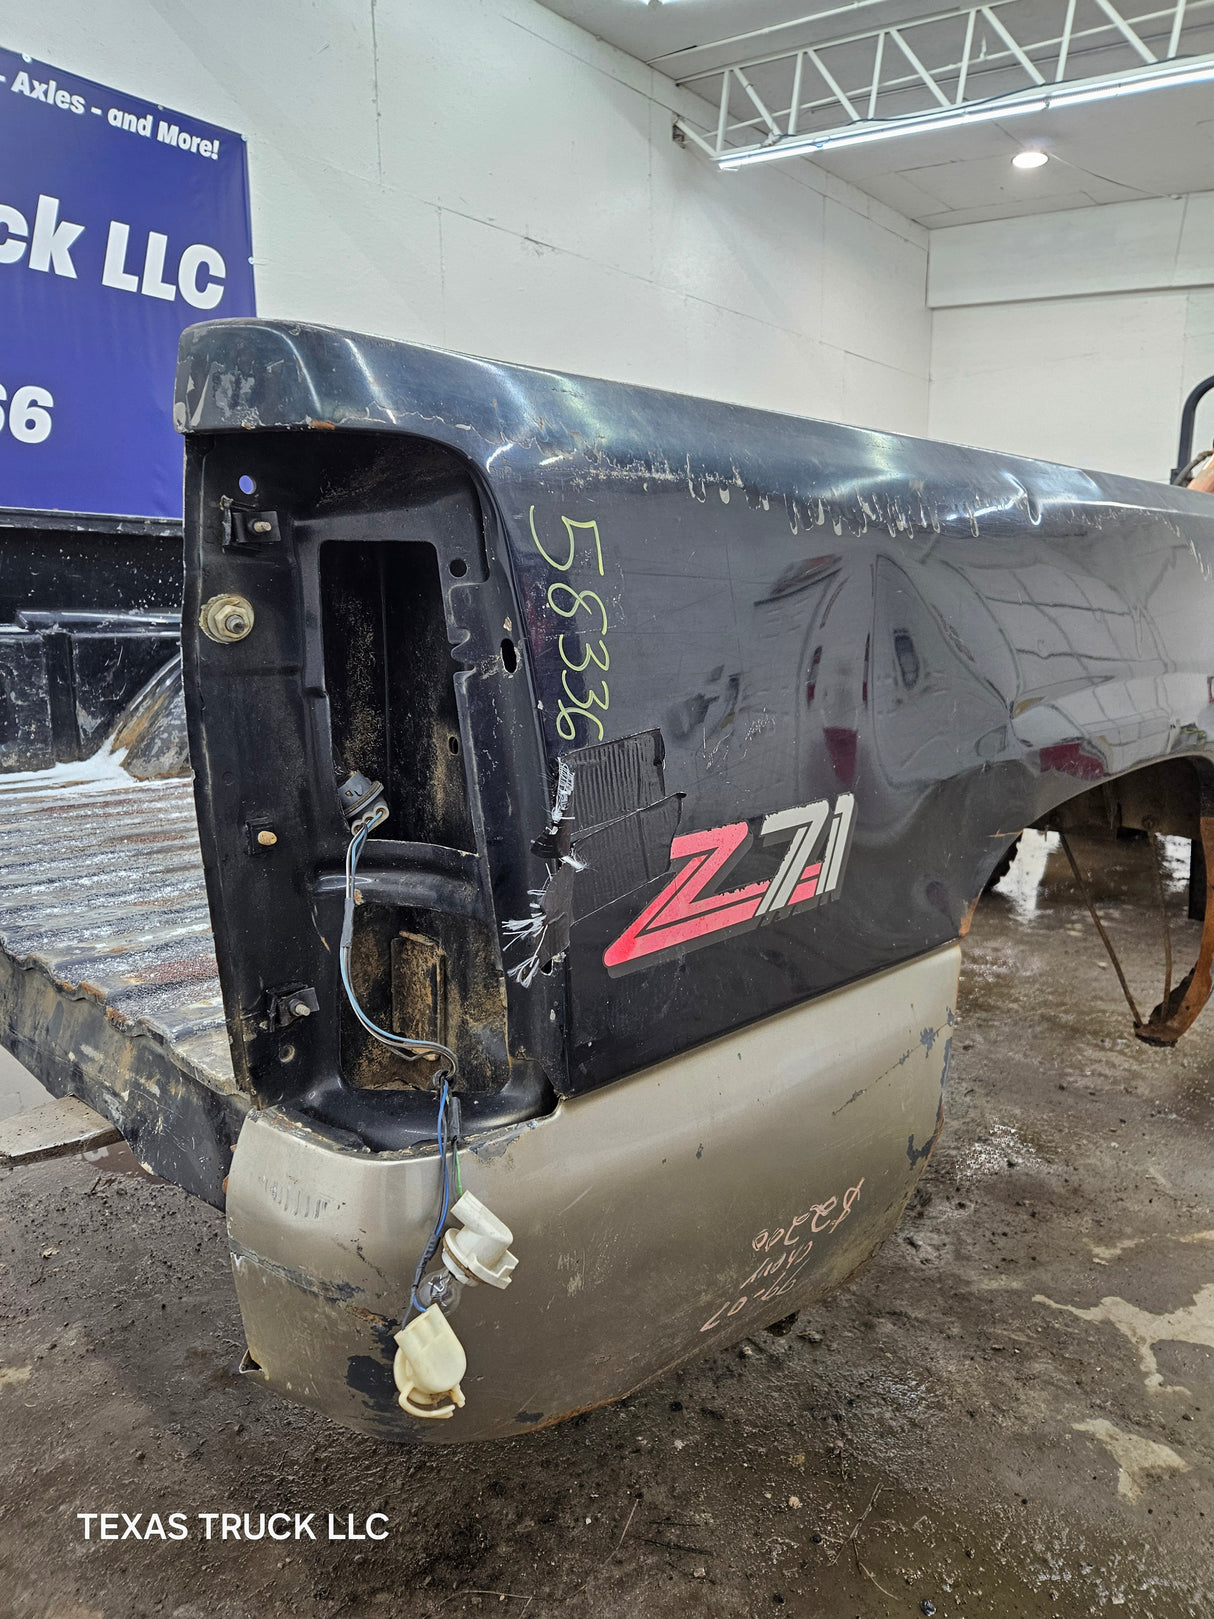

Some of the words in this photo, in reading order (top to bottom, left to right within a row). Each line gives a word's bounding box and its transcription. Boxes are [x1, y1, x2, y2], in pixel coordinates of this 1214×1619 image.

[11, 71, 86, 114] Axles
[107, 108, 154, 138] and
[157, 121, 220, 160] More!
[102, 220, 226, 310] LLC
[0, 384, 54, 444] 6
[530, 505, 610, 741] 58336
[603, 791, 857, 972] Z71
[700, 1257, 811, 1332] 99-07
